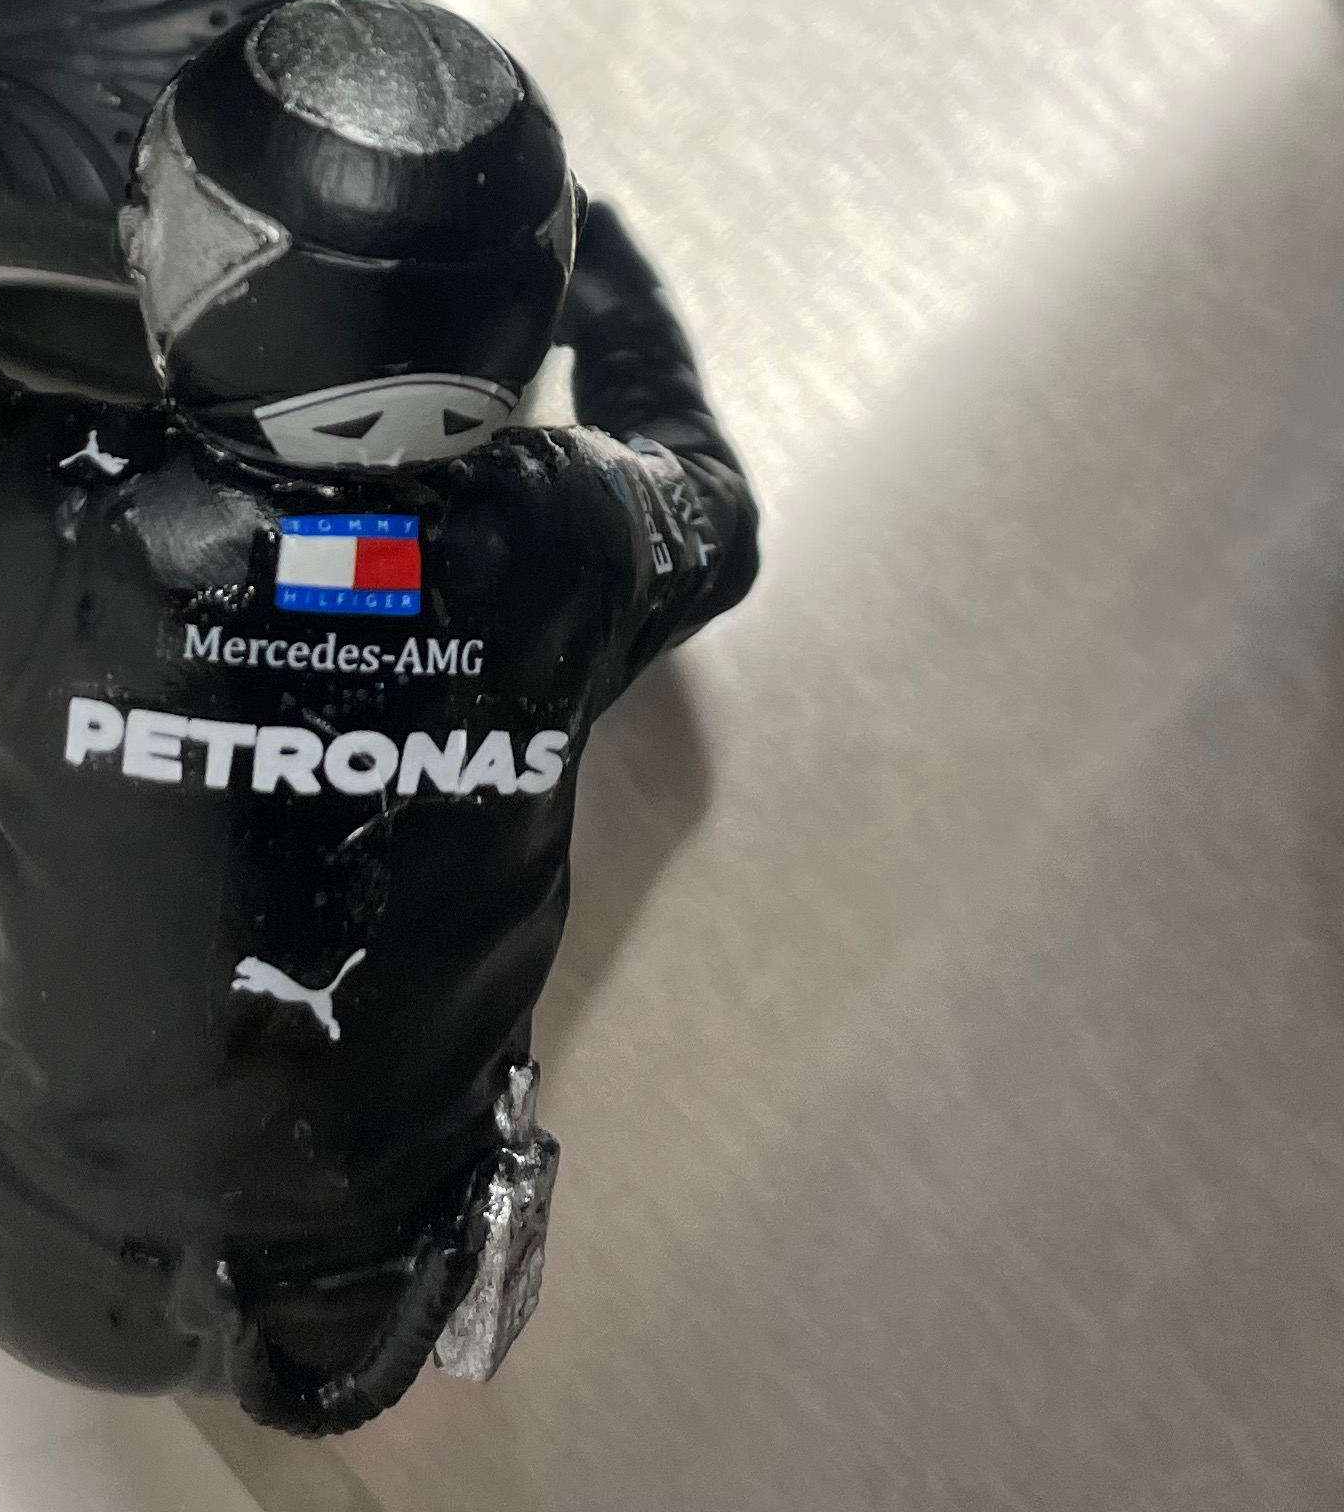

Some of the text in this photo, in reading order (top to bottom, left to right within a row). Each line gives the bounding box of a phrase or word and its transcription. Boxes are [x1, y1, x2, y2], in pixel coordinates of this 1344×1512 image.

[289, 519, 414, 533] TOMMY
[283, 590, 412, 608] HILFIGER
[183, 624, 484, 676] Mercedes-AMG
[64, 697, 568, 795] PETRONAS
